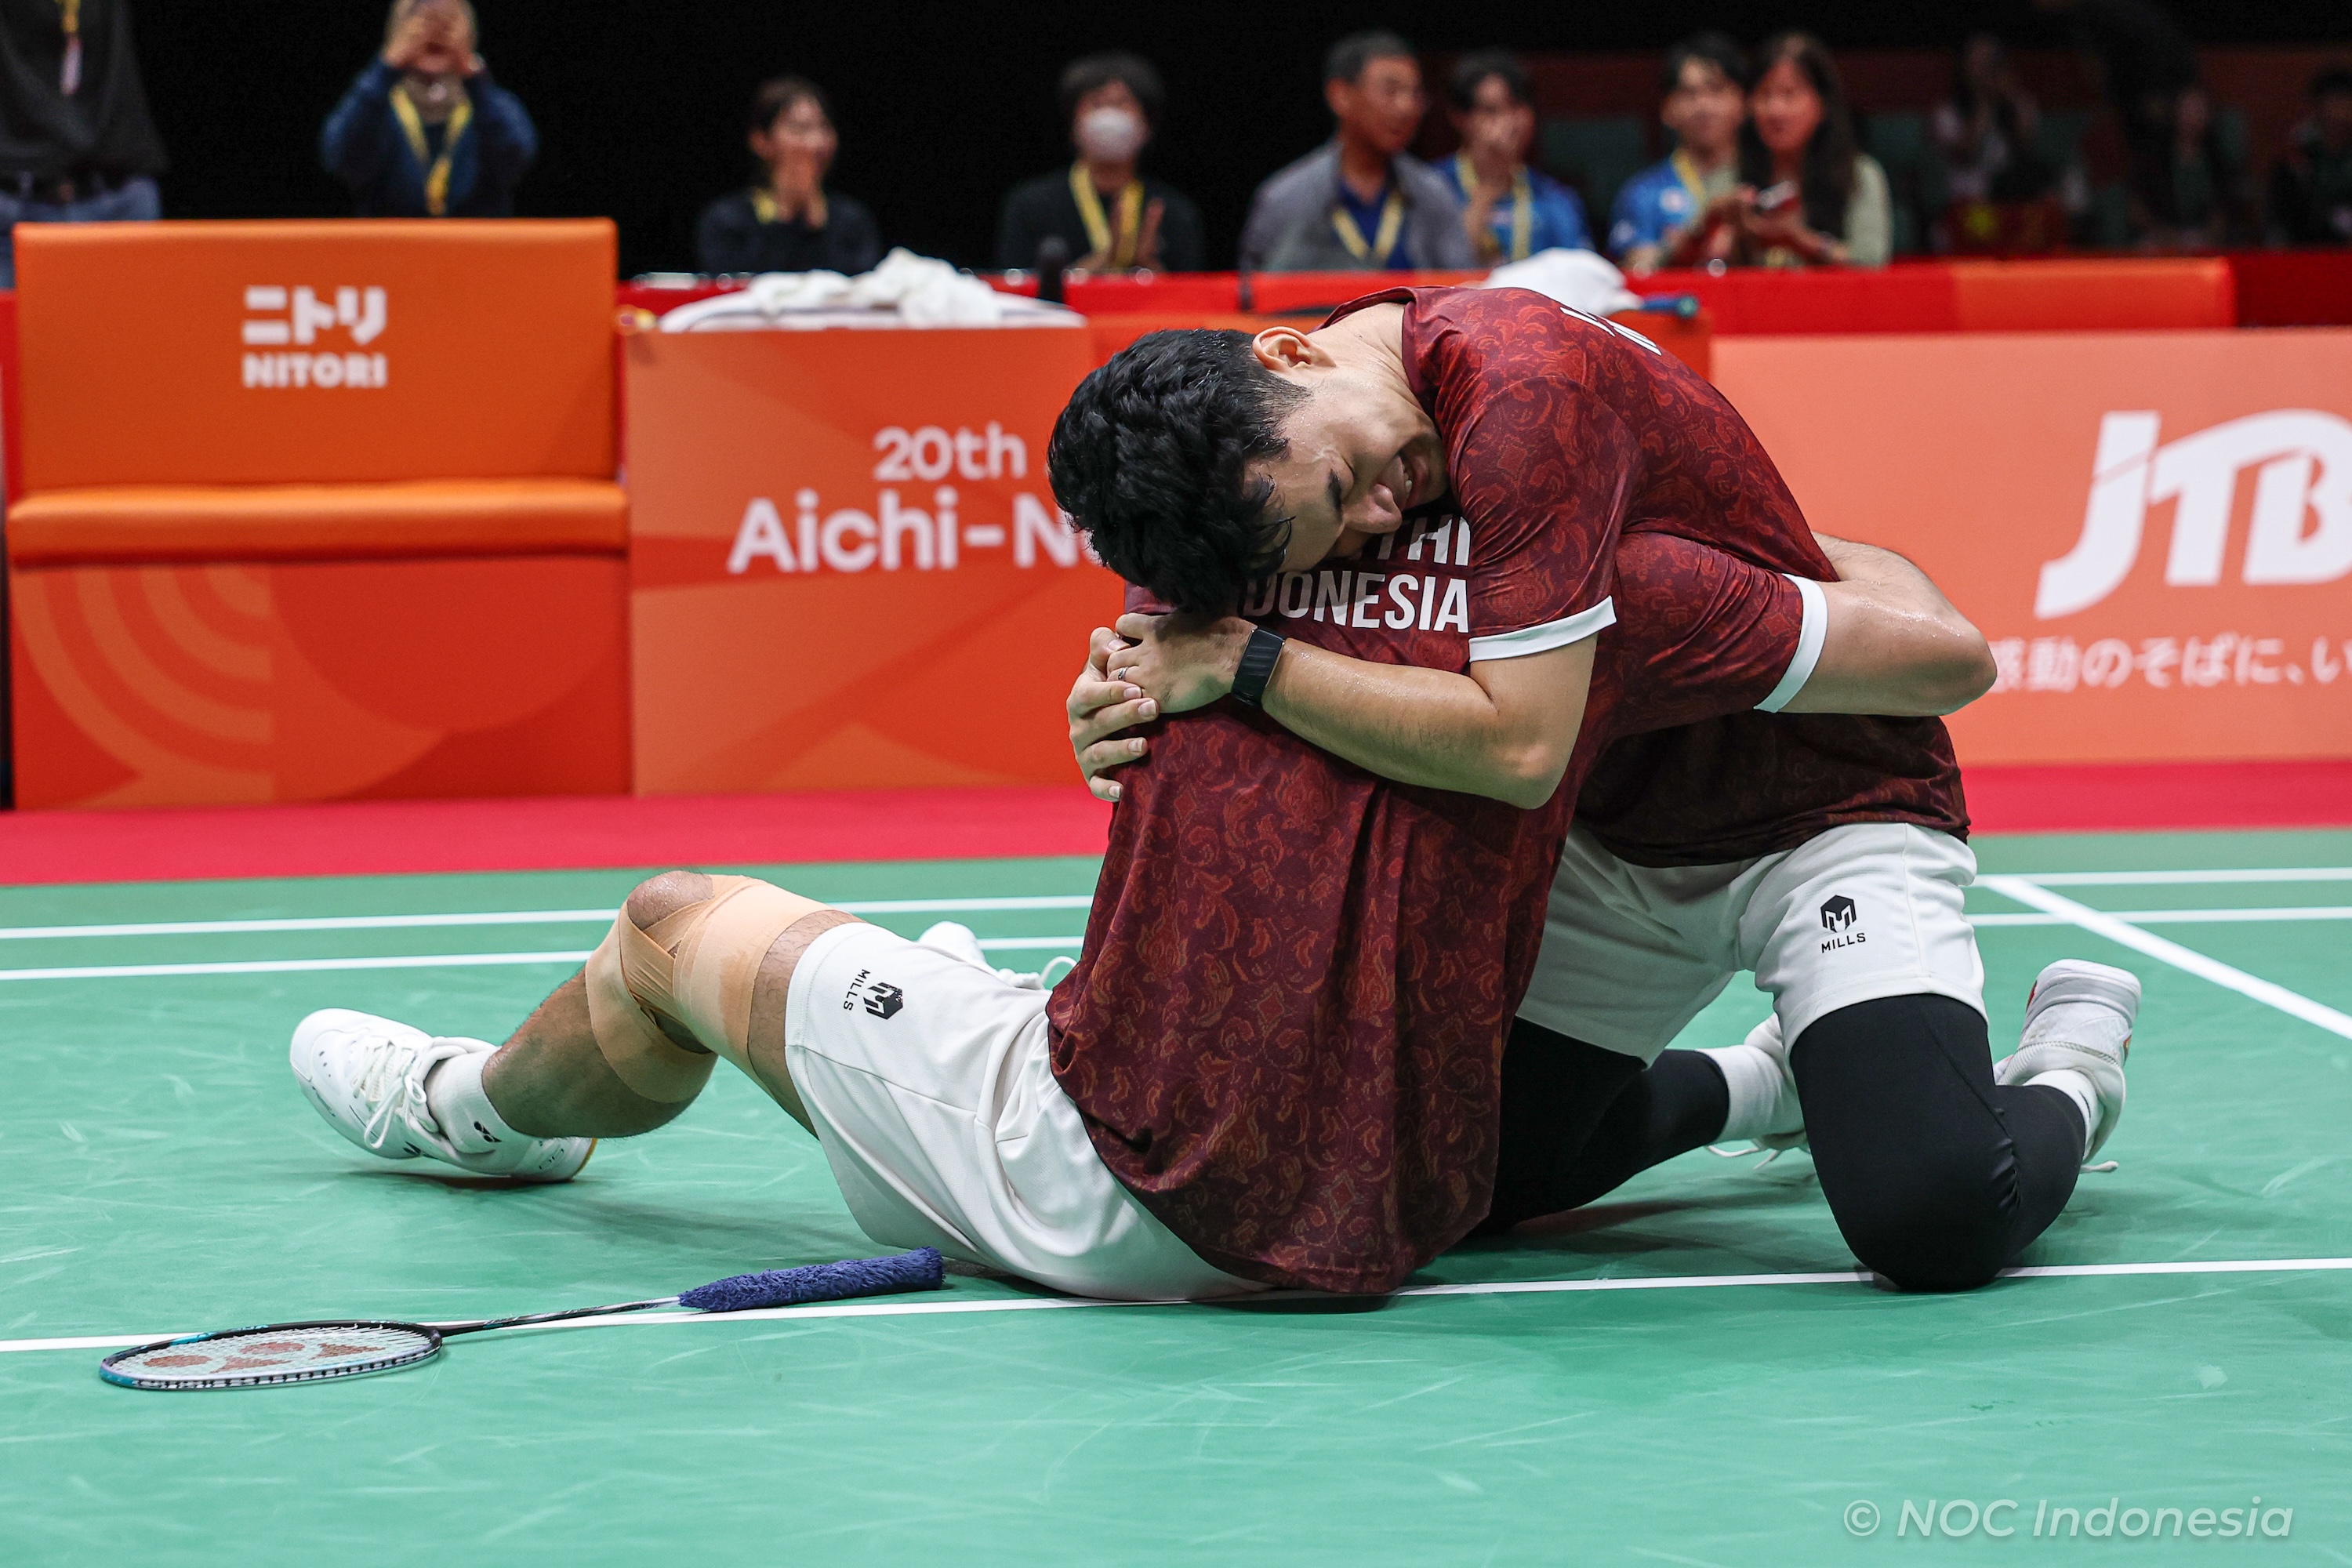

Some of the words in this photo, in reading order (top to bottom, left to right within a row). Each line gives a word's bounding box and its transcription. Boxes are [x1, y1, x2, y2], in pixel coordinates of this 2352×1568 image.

[242, 284, 387, 347] ニトリ
[242, 353, 387, 389] NITORI
[873, 421, 1028, 481] 20th
[727, 485, 1104, 574] Aichi-N
[2034, 408, 2352, 620] JTB
[1243, 570, 1469, 633] DONESIA
[1821, 932, 1866, 953] MILLS
[843, 969, 871, 1011] MILLS
